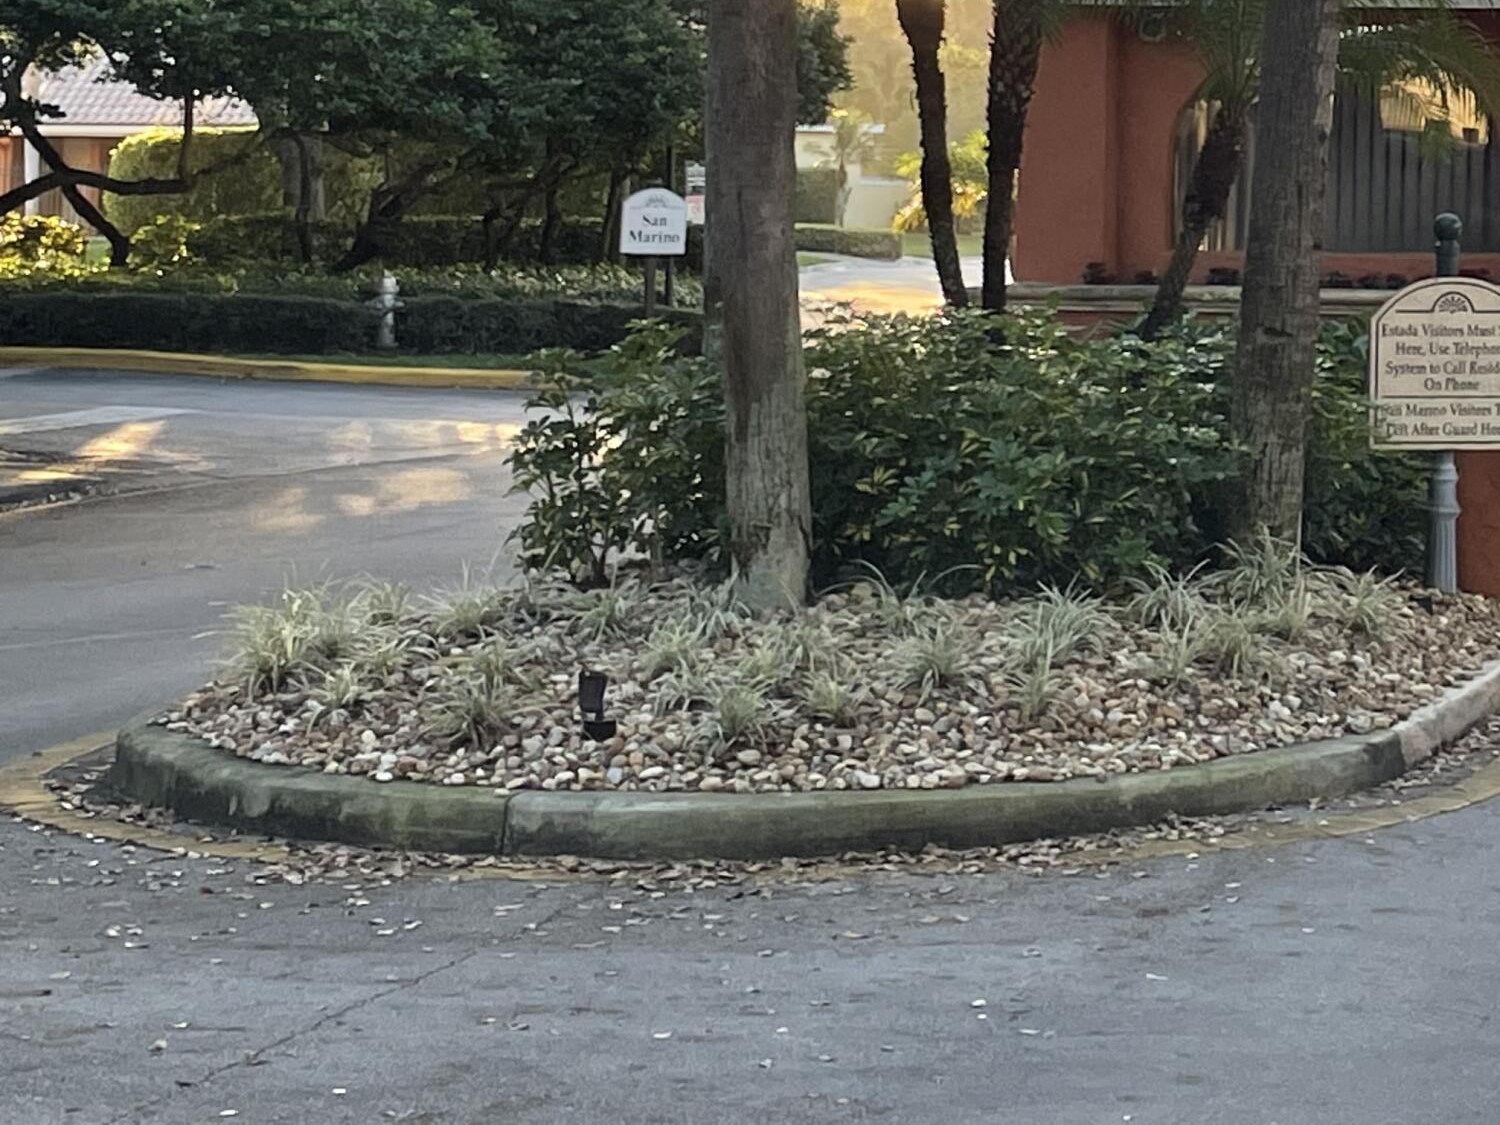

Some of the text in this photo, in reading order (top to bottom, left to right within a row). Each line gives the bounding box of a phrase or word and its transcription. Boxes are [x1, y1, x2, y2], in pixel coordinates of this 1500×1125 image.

[642, 215, 667, 226] San
[629, 230, 680, 243] Marino
[1382, 324, 1418, 337] Estada
[1421, 324, 1464, 337] Visitors
[1467, 324, 1496, 337] Must
[1395, 343, 1426, 356] Here,
[1429, 343, 1450, 356] Use
[1385, 362, 1427, 377] System
[1429, 363, 1441, 375] to
[1443, 361, 1466, 375] Call
[1424, 378, 1480, 391] On Phone
[1405, 403, 1447, 416] Marino
[1449, 403, 1492, 416] Visitors
[1411, 422, 1440, 435] After
[1442, 422, 1478, 436] Guard
